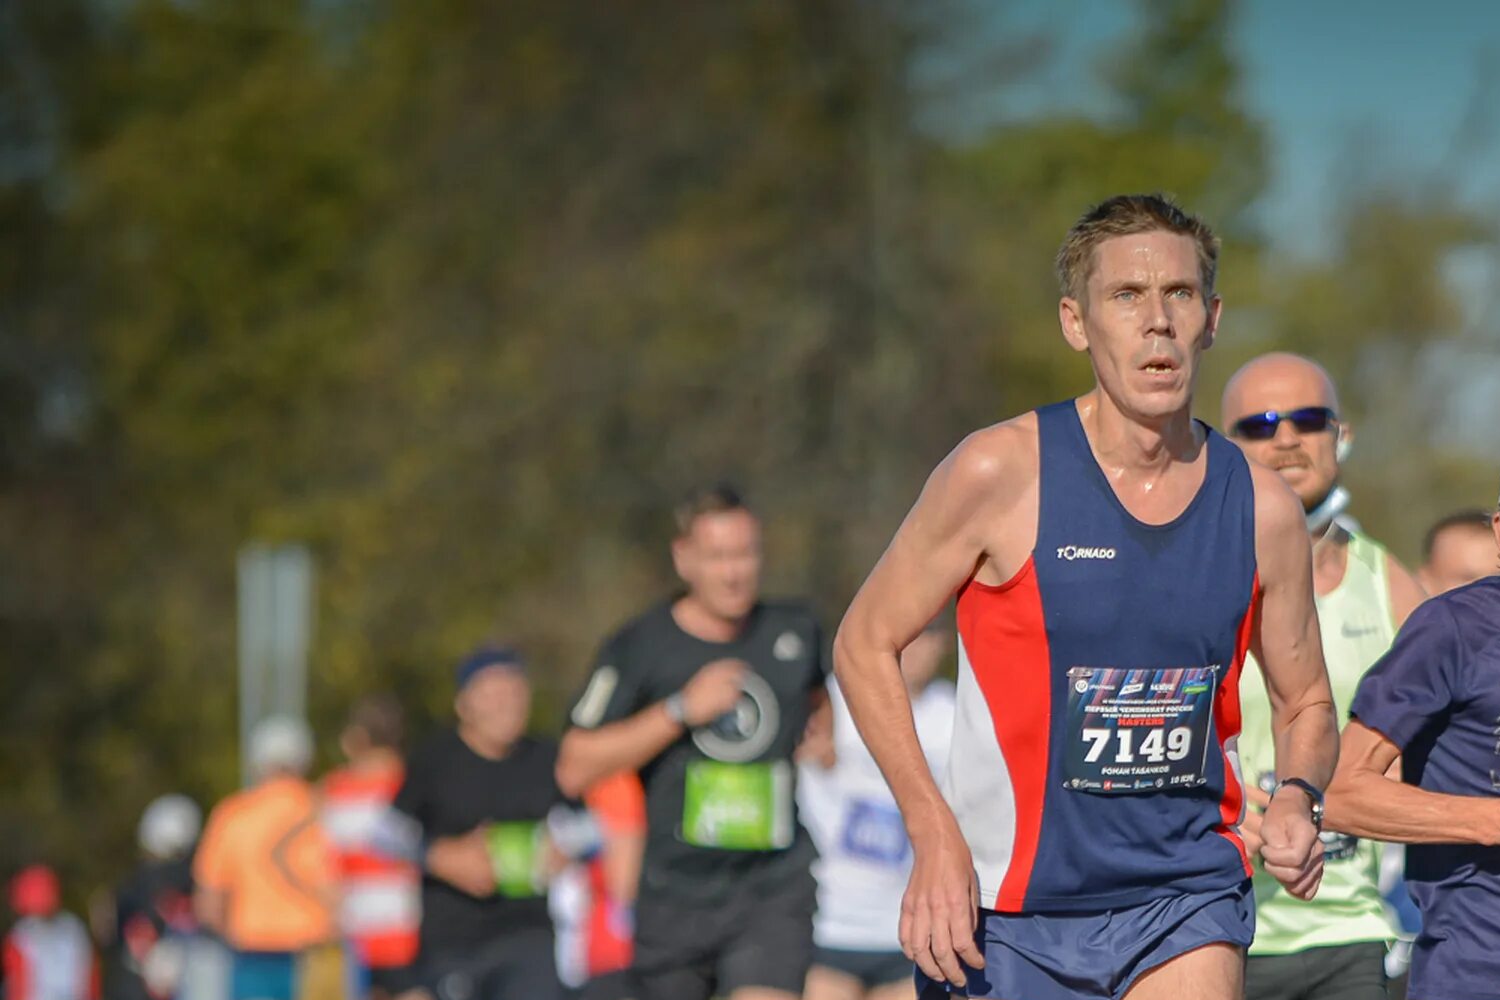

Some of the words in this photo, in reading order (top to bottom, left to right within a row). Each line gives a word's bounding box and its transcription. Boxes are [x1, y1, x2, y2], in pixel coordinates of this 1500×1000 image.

[1057, 545, 1115, 560] TORNADO
[1117, 718, 1165, 726] MASTERS
[1082, 727, 1192, 763] 7149
